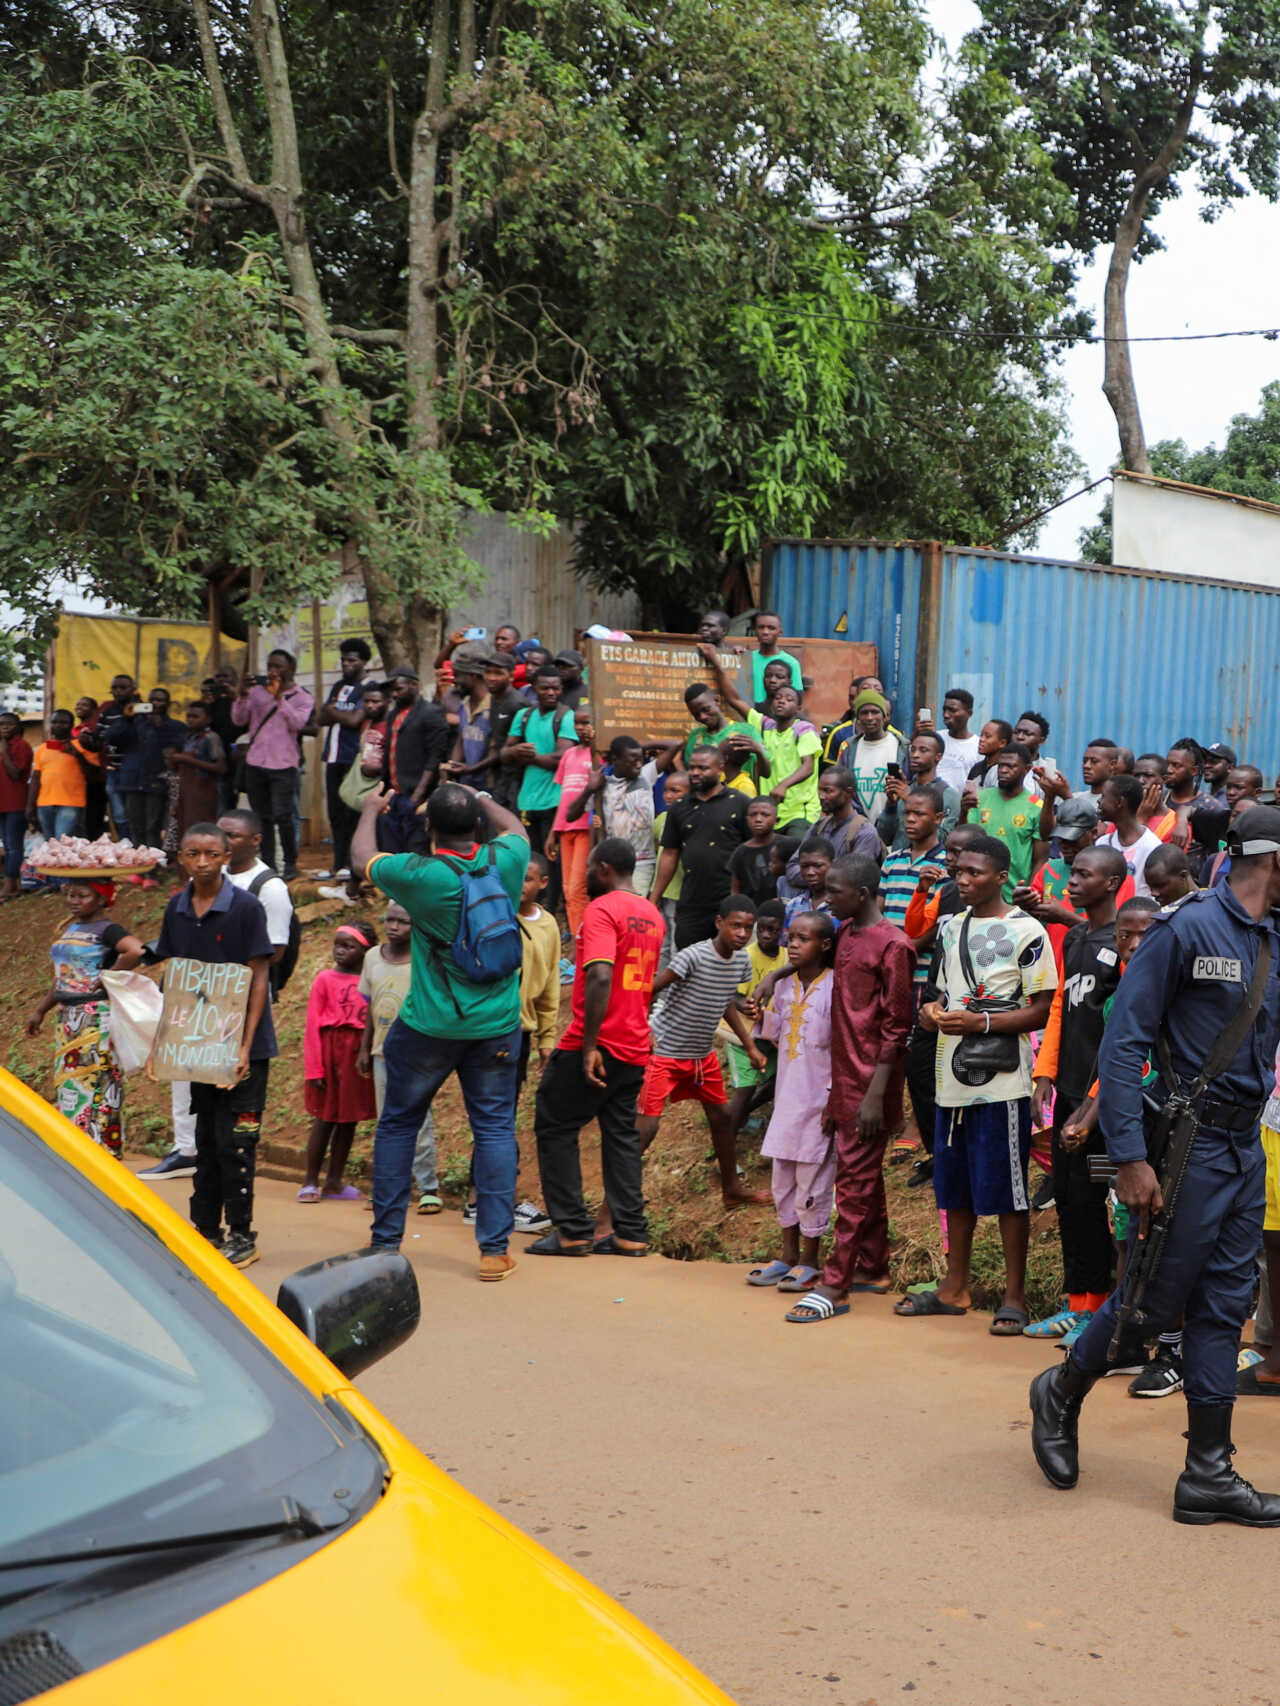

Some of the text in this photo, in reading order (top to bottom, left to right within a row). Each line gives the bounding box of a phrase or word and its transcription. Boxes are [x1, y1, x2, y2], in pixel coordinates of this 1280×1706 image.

[601, 645, 623, 661] ETS
[624, 648, 669, 666] GARAGE
[671, 652, 699, 668] AUTO
[169, 958, 249, 996] MBAPPE
[1197, 960, 1237, 978] POLICE
[170, 997, 218, 1040] LE 10
